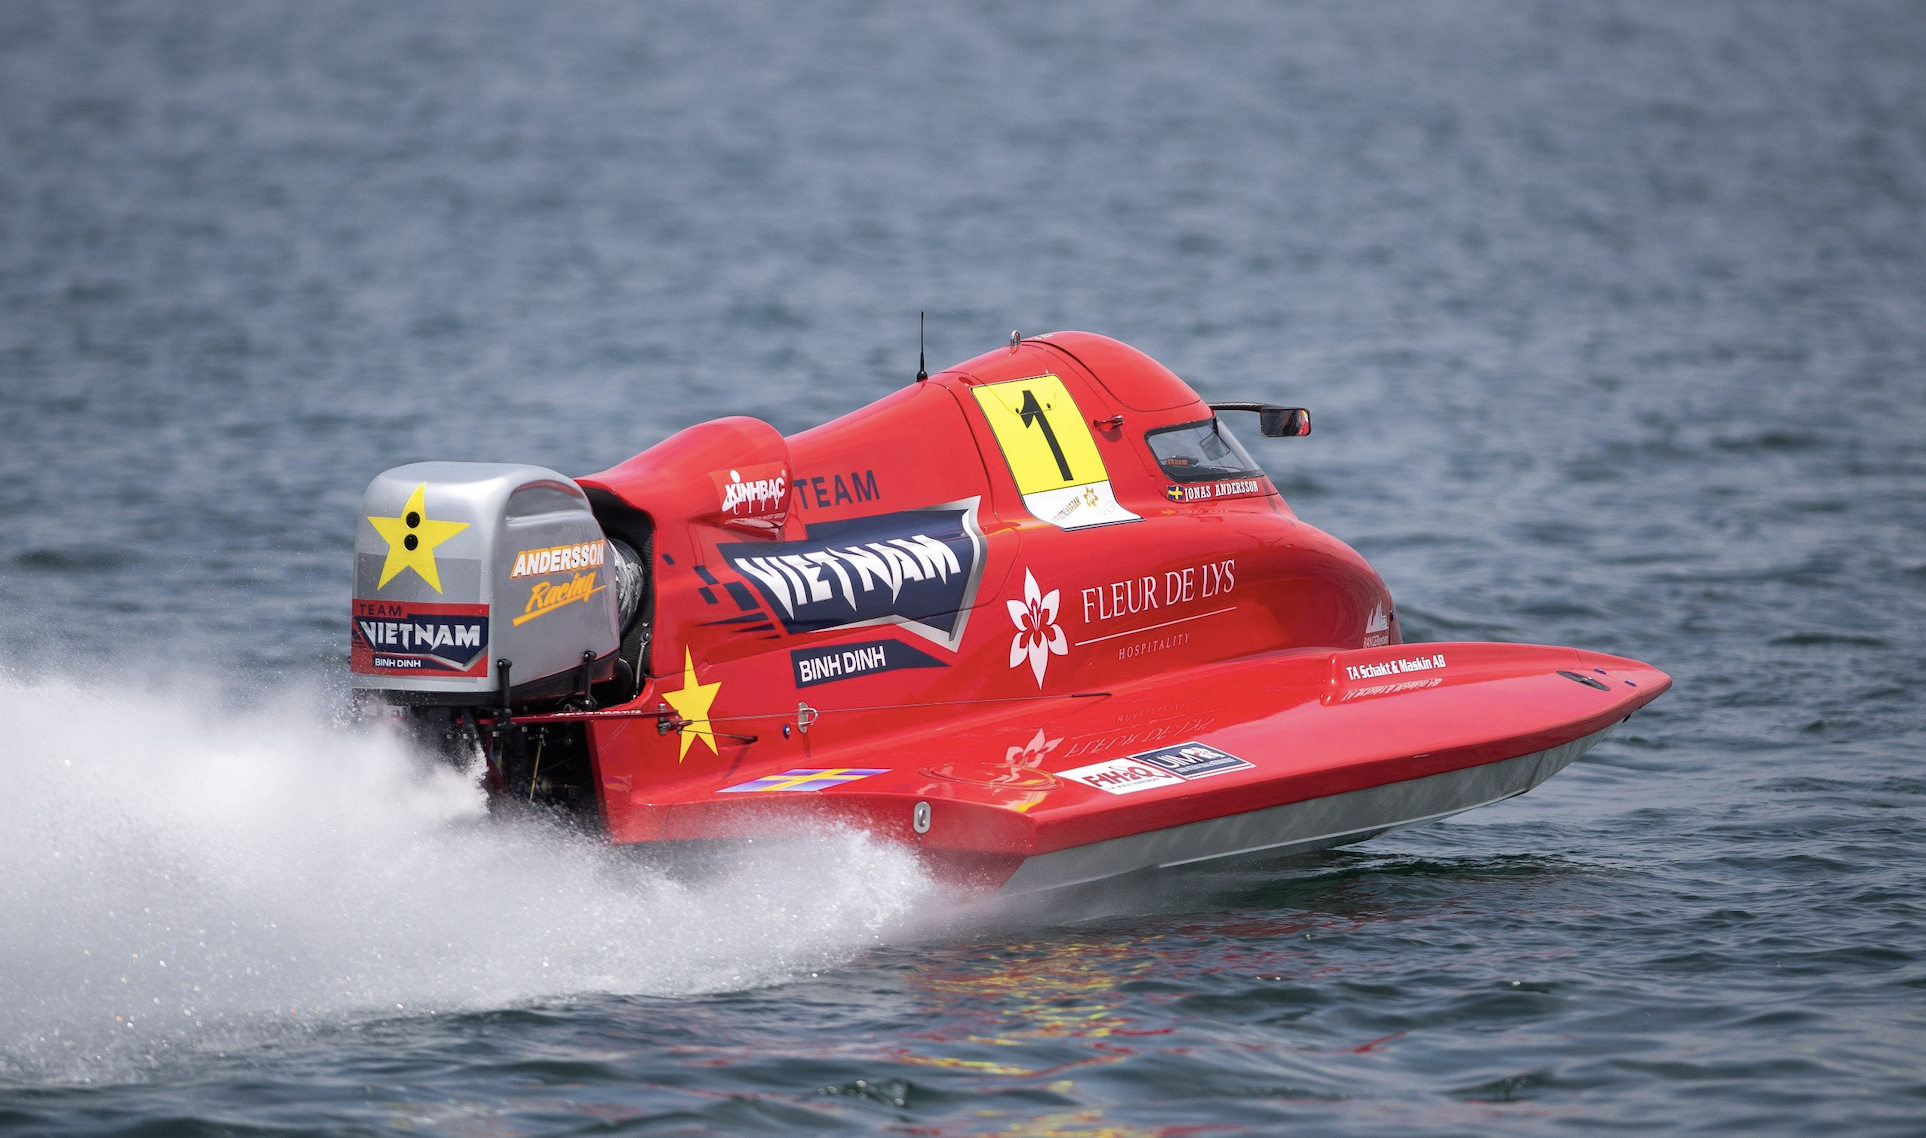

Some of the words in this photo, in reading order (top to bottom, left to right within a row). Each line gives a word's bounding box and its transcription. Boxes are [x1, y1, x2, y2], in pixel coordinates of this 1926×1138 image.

[1019, 389, 1074, 482] 1
[793, 469, 881, 510] TEAM
[1184, 486, 1211, 502] JONAS
[1215, 481, 1259, 497] ANDERSSON
[511, 541, 605, 578] ANDERSSON
[734, 534, 962, 620] VIETNAM
[525, 571, 596, 613] Racing
[1081, 574, 1160, 624] FLEUR
[1164, 571, 1197, 607] DE
[1201, 558, 1236, 598] LYS
[360, 604, 402, 616] TEAM
[359, 620, 481, 650] VIETNAM
[1118, 632, 1191, 661] HOSPITALITY
[374, 658, 396, 667] BINH
[397, 659, 422, 668] DINH
[799, 654, 842, 683] BINH
[843, 645, 886, 674] DINH
[1346, 666, 1361, 681] TA
[1359, 662, 1390, 679] Schakt
[1390, 660, 1400, 675] &
[1398, 657, 1433, 673] Maskin
[1432, 654, 1446, 669] AB
